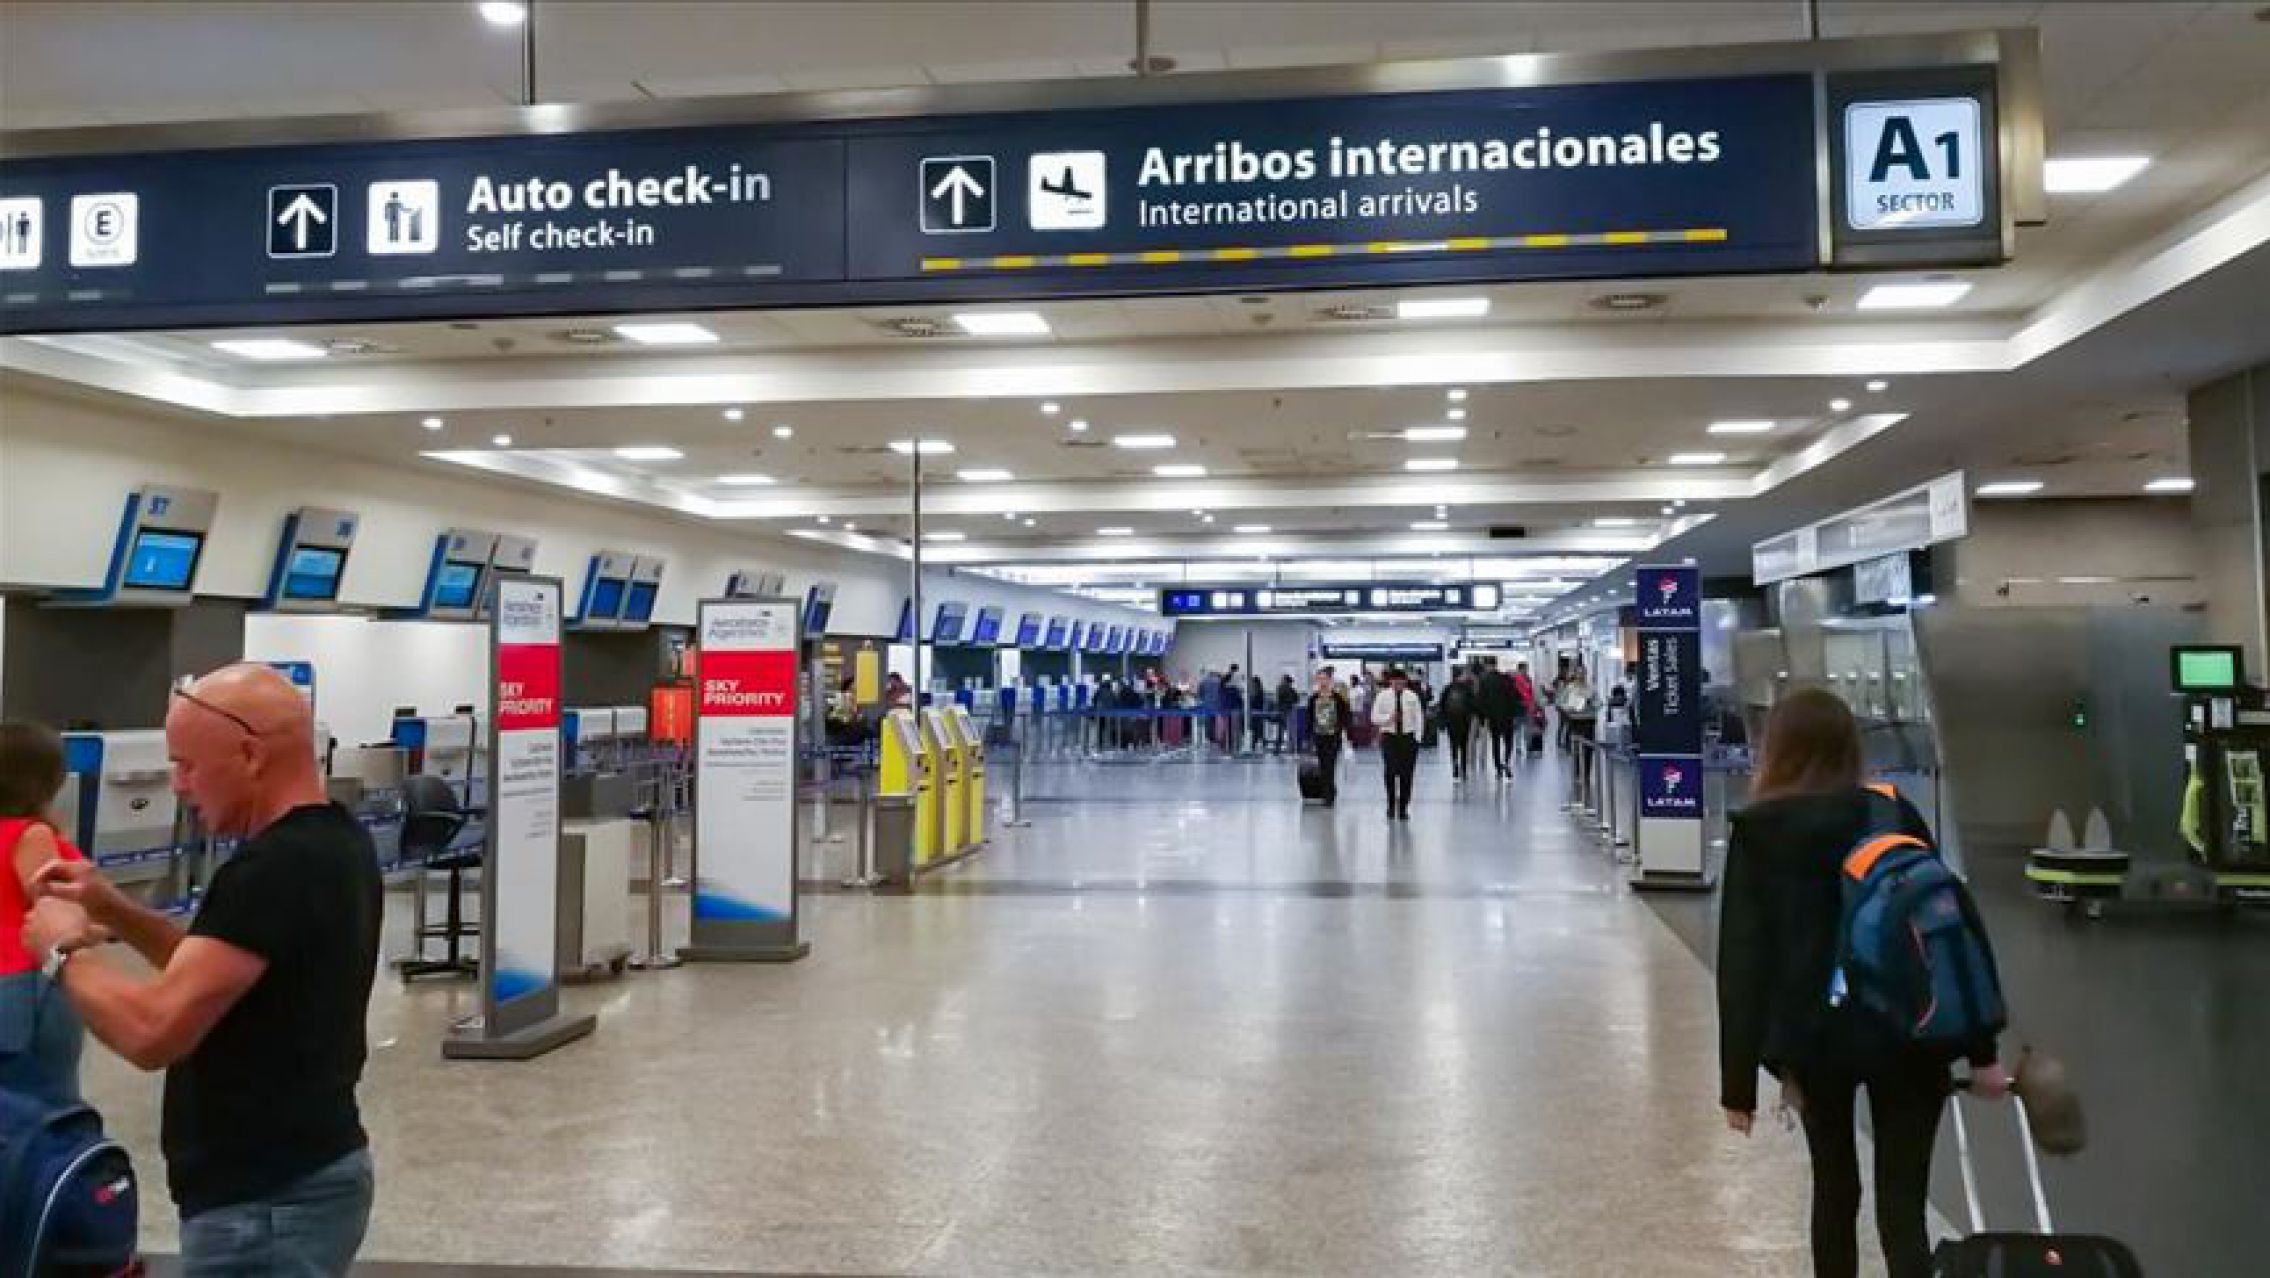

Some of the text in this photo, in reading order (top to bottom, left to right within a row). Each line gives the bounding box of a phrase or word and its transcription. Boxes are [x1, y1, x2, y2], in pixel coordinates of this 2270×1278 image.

[1137, 121, 1720, 186] Arribos internacionales
[467, 163, 771, 213] Auto check-in
[1139, 184, 1480, 227] International arrivals
[1876, 192, 1955, 213] SECTOR
[96, 210, 112, 236] E
[467, 218, 655, 250] Self check-in
[1644, 607, 1693, 618] LATAM
[1646, 639, 1661, 692] Ventas
[704, 679, 741, 692] SKY
[704, 692, 786, 706] PRIORITY
[1647, 797, 1696, 807] LATAM
